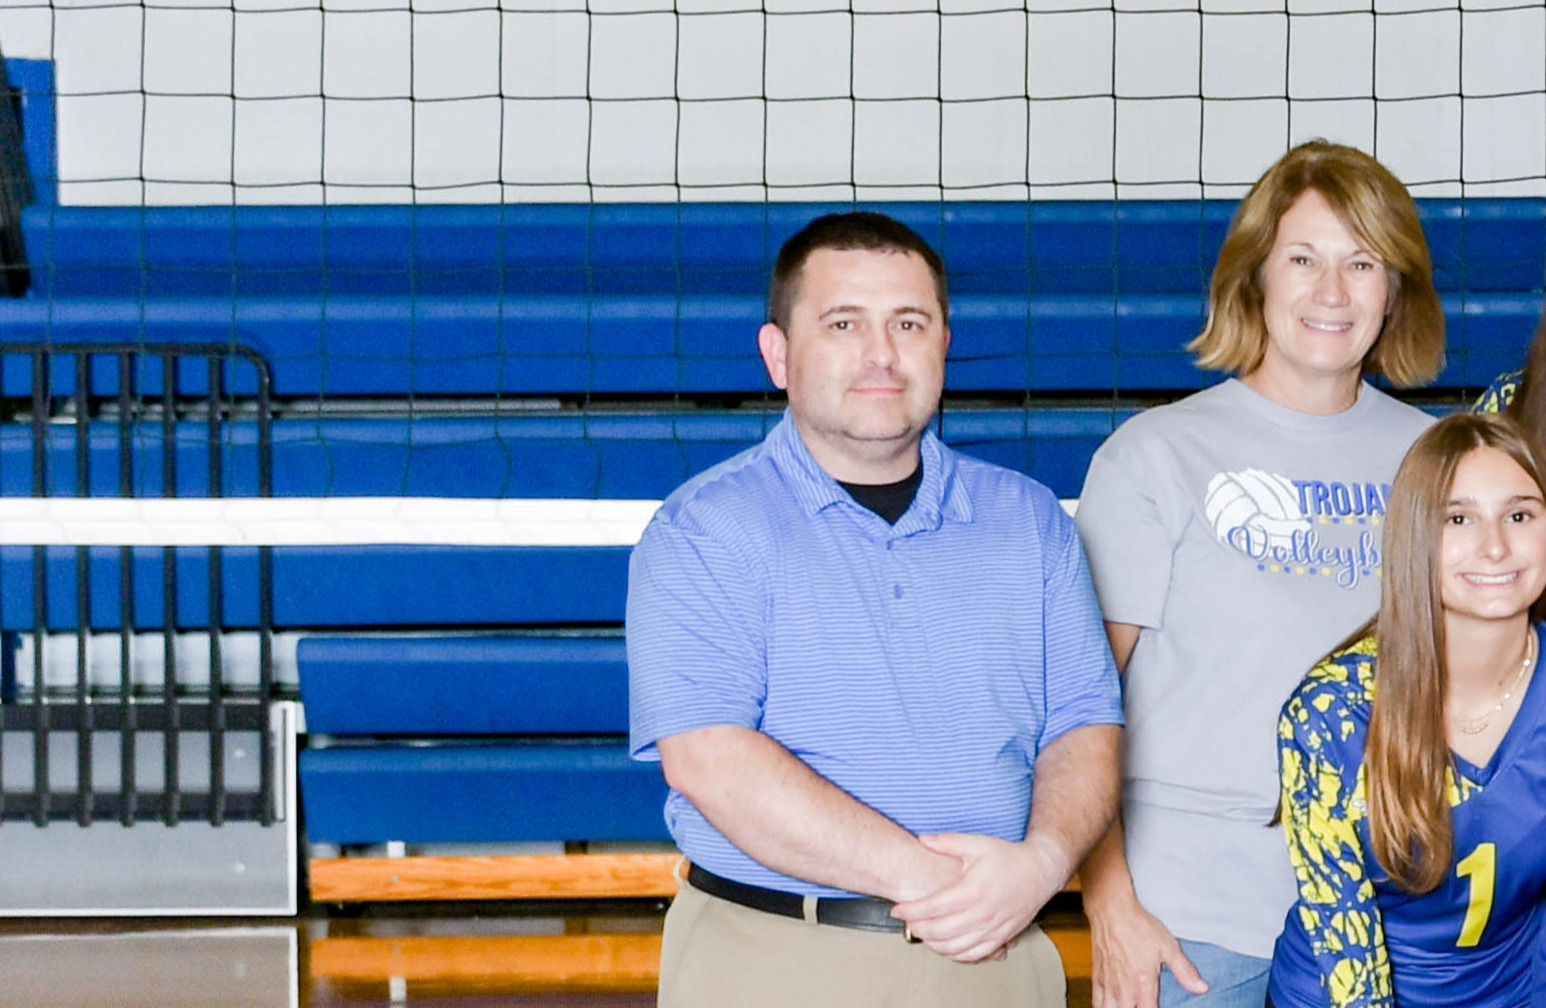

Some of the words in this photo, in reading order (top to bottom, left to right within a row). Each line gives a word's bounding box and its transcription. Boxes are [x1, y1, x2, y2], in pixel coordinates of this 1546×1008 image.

[1291, 479, 1393, 517] TROJA
[1226, 525, 1383, 589] Volleyb
[1455, 843, 1496, 948] 1
